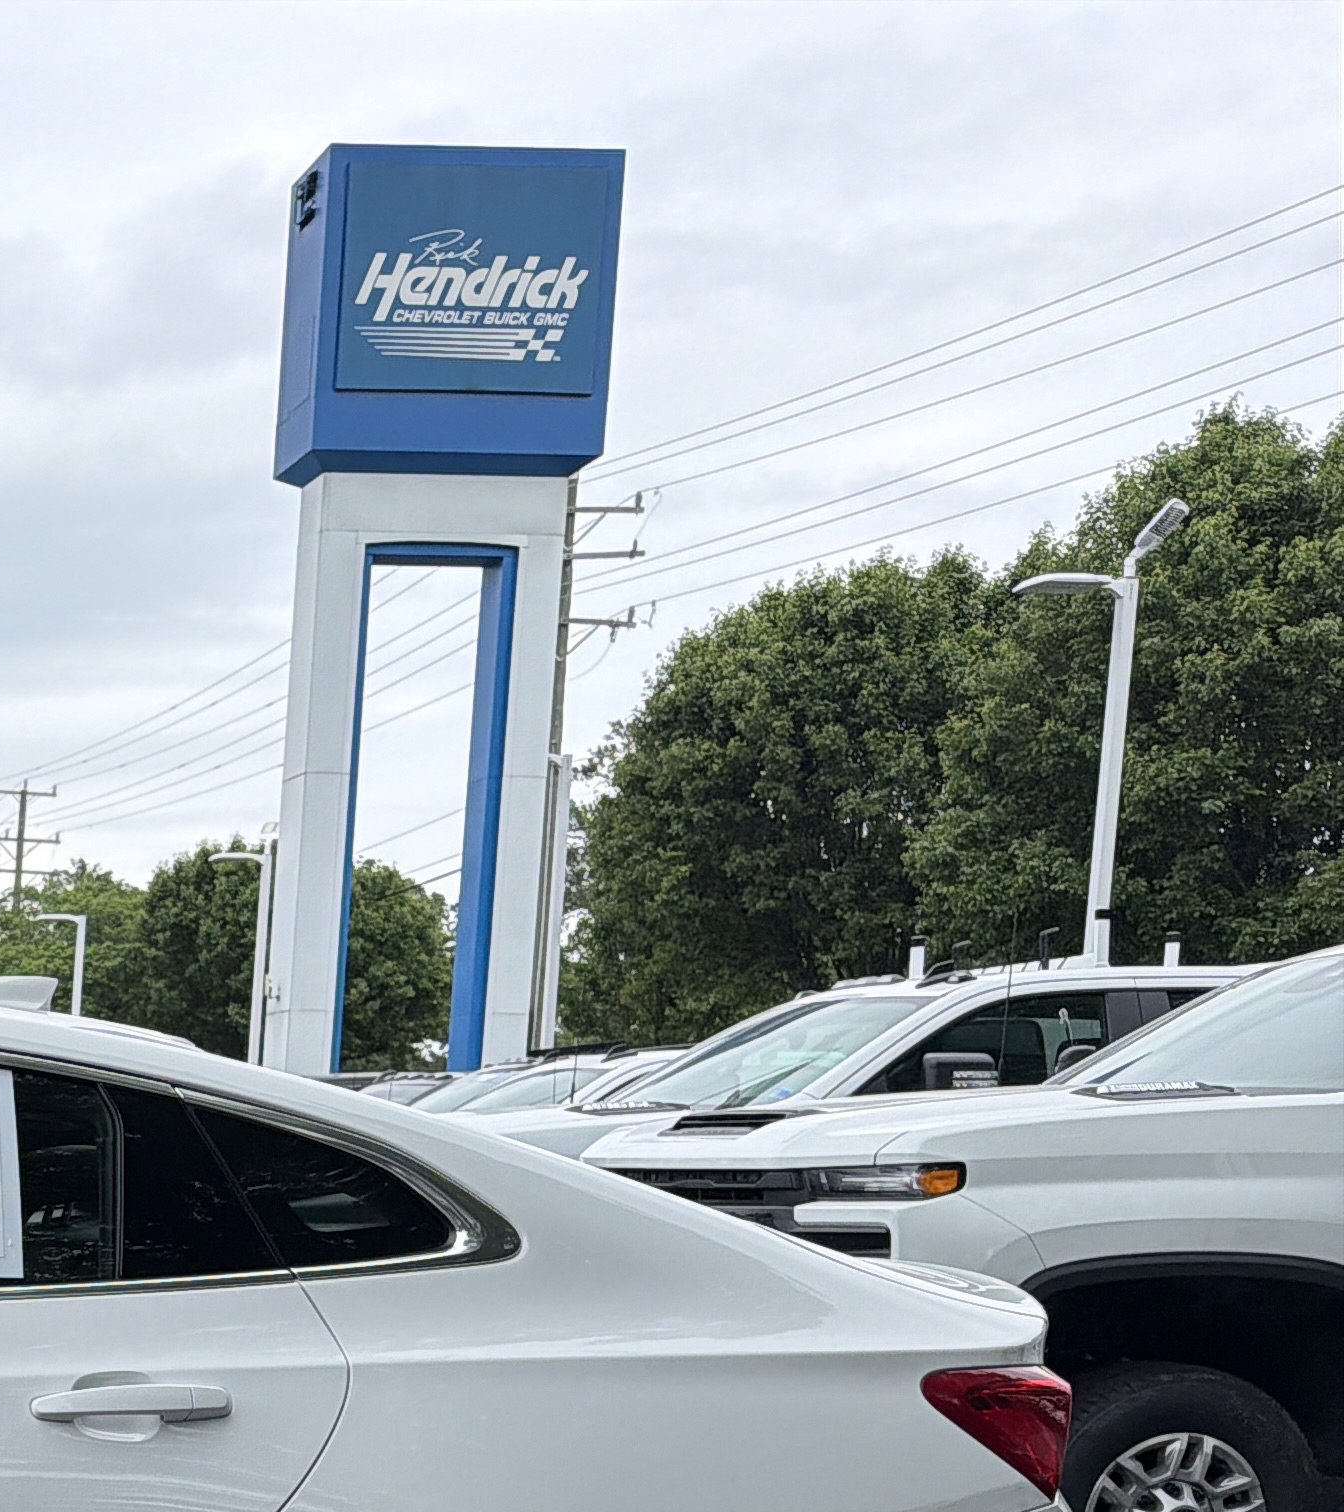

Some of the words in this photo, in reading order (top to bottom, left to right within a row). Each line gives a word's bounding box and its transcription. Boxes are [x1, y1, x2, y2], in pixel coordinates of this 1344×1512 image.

[354, 252, 590, 322] Hendrick
[392, 309, 482, 325] CHEVROLET
[484, 311, 531, 326] BUICK
[533, 312, 570, 326] GMC
